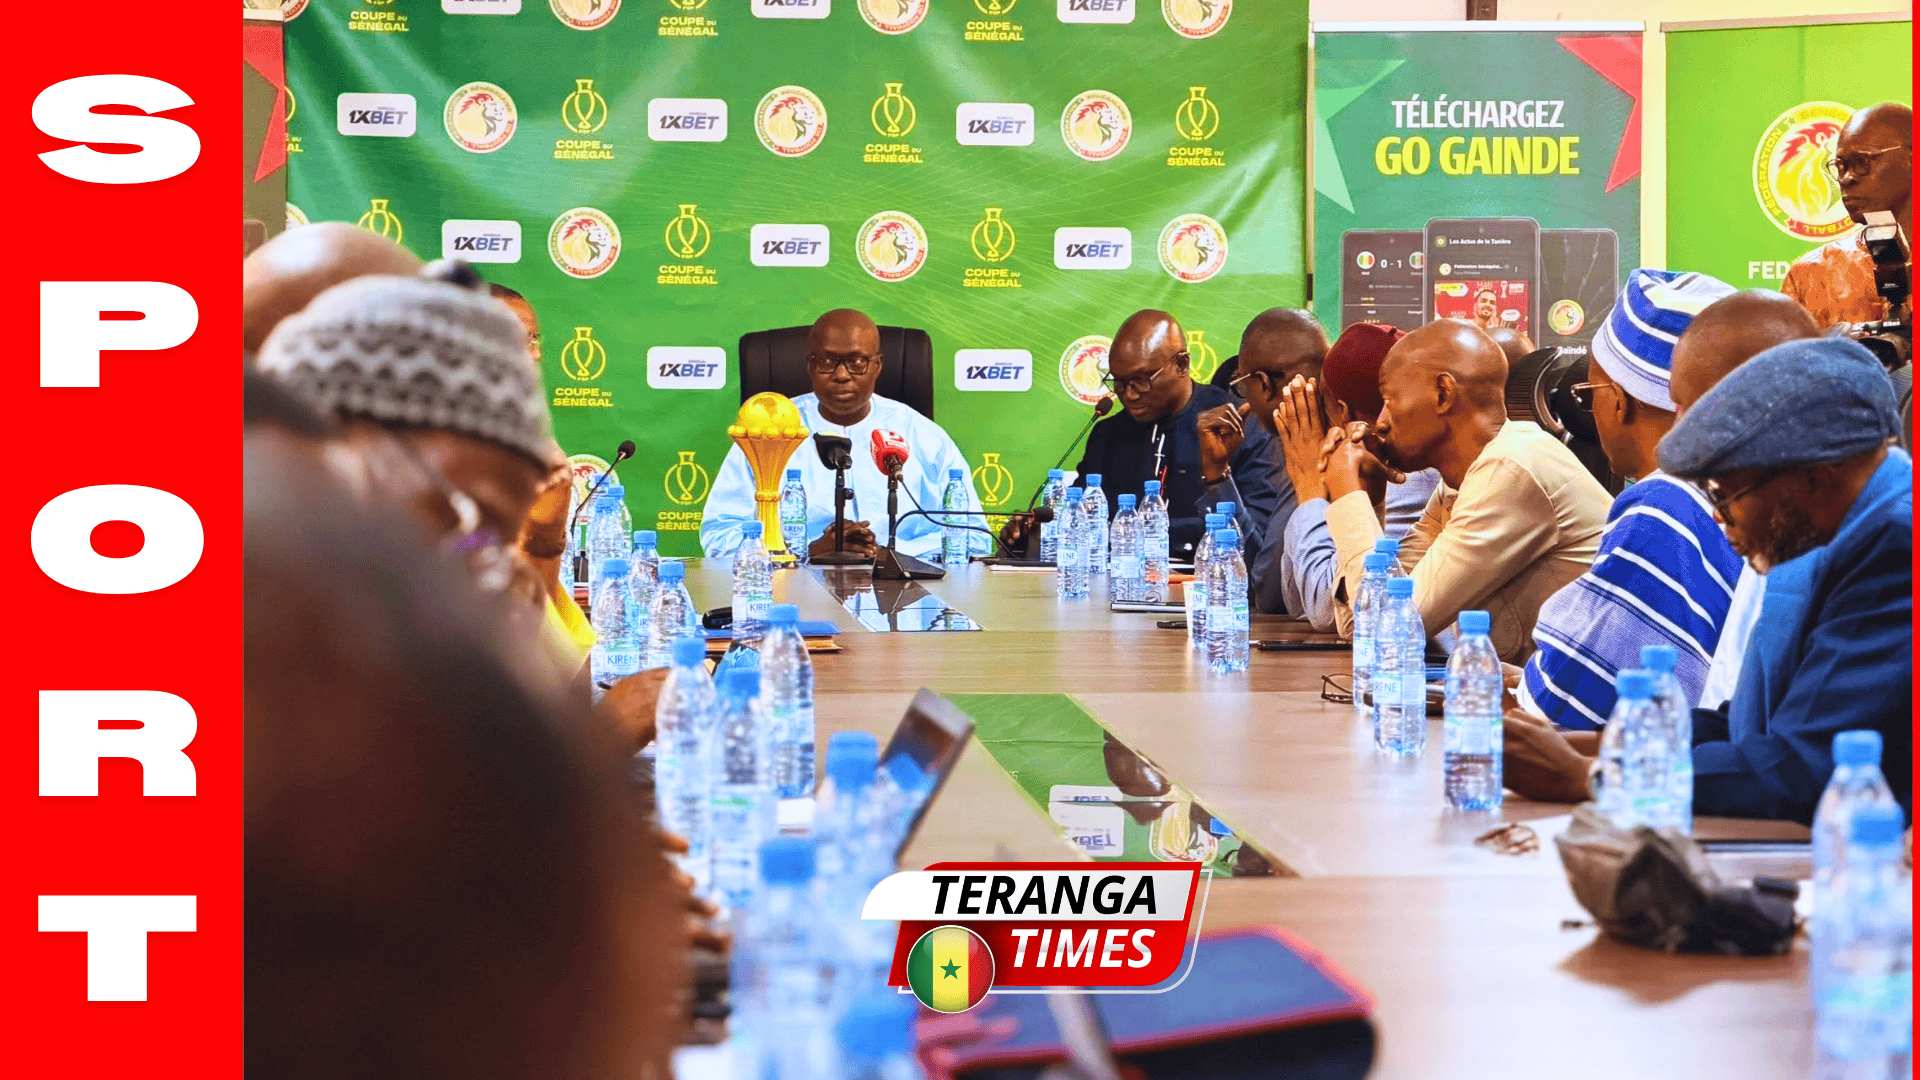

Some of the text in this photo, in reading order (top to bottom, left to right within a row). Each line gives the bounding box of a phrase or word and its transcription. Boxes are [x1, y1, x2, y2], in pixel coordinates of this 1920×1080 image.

[350, 11, 396, 22] COUPE
[660, 17, 705, 26] COUPE
[966, 21, 1011, 31] COUPE
[1391, 94, 1565, 128] TÉLÉCHARGEZ
[349, 110, 408, 125] 1XBET
[660, 115, 719, 130] 1XBET
[968, 120, 1026, 134] 1XBET
[556, 140, 601, 150] COUPE
[865, 144, 910, 153] COUPE
[1169, 147, 1212, 157] COUPE
[1375, 136, 1580, 175] GO GAINDE
[454, 237, 513, 251] 1XBET
[762, 241, 821, 255] 1XBET
[1066, 244, 1124, 258] 1XBET
[659, 265, 704, 274] COUPE
[1380, 259, 1388, 269] 0
[1396, 259, 1402, 269] 1
[965, 268, 1009, 278] COUPE
[659, 363, 718, 377] 1XBET
[966, 366, 1025, 380] 1XBET
[555, 388, 600, 397] COUPE
[658, 512, 703, 521] COUPE
[656, 520, 700, 531] SÉNÉG
[1374, 682, 1398, 693] RENE
